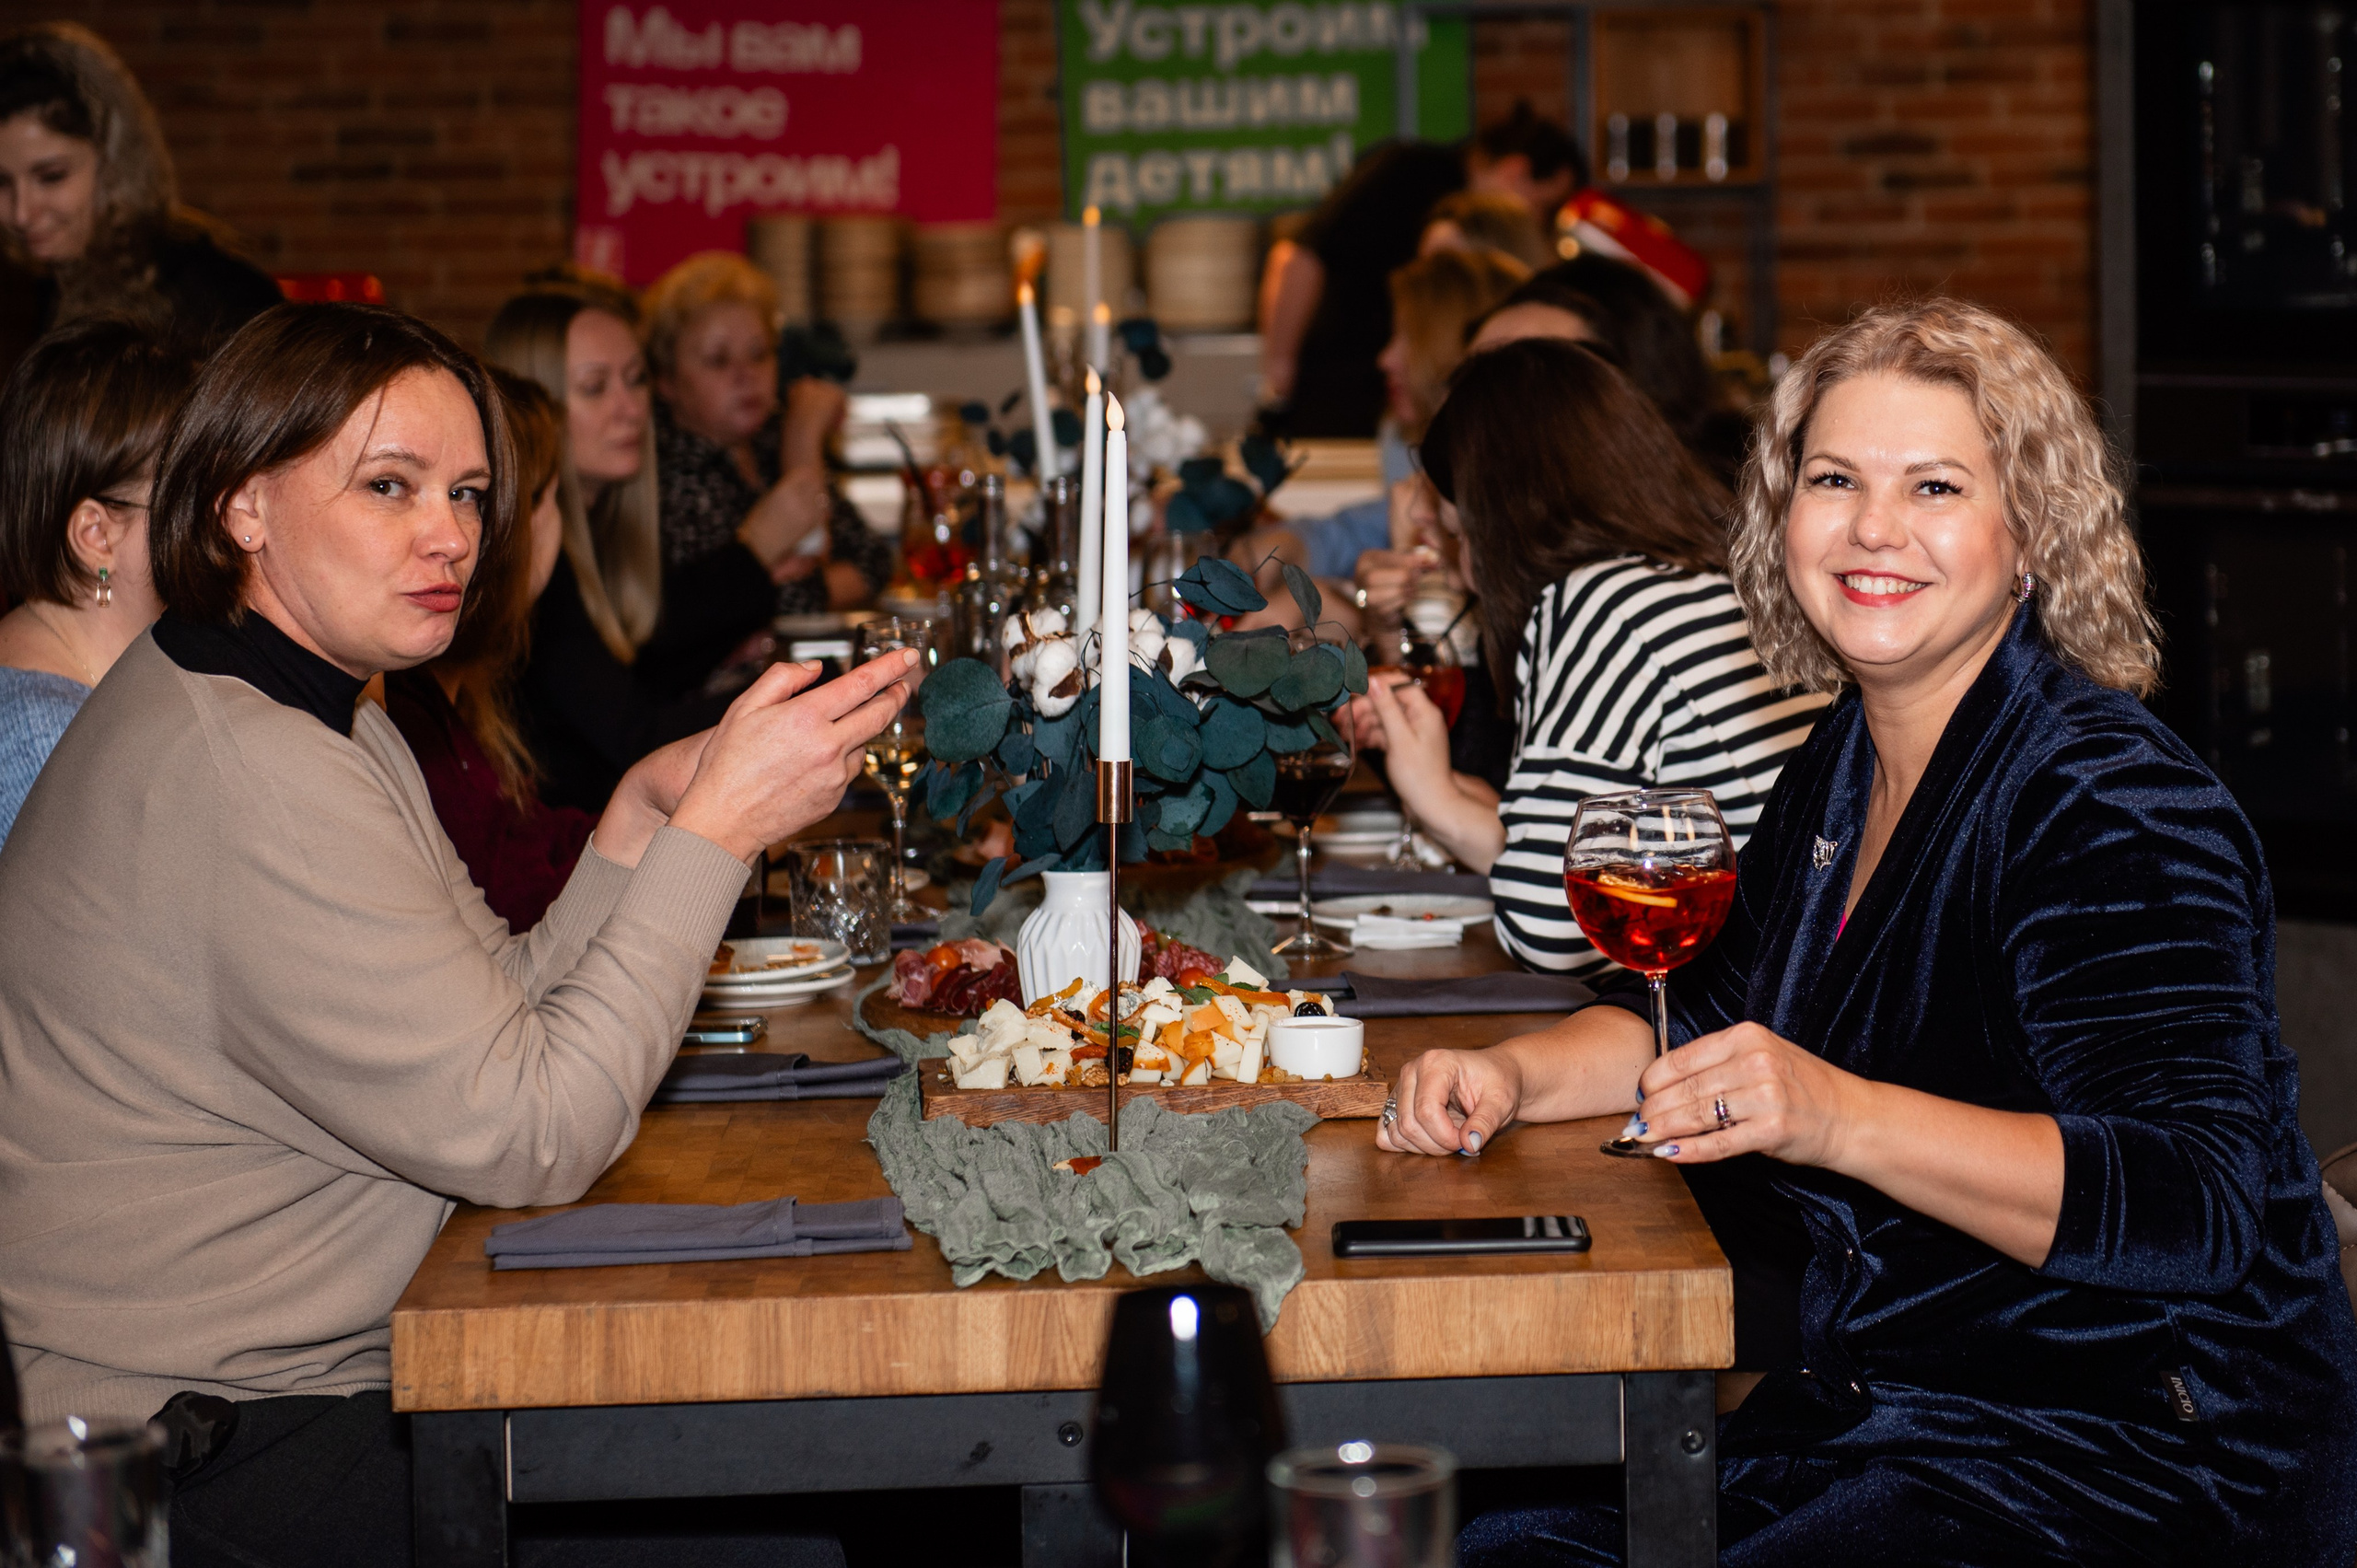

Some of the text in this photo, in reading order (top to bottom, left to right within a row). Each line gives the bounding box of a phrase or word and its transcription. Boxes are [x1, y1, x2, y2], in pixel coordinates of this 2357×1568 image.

[605, 6, 862, 73] Мы вам
[603, 84, 788, 140] такое
[1082, 75, 1359, 133] вашим
[601, 144, 900, 217] устроим!
[2171, 1376, 2194, 1413] INICIO
